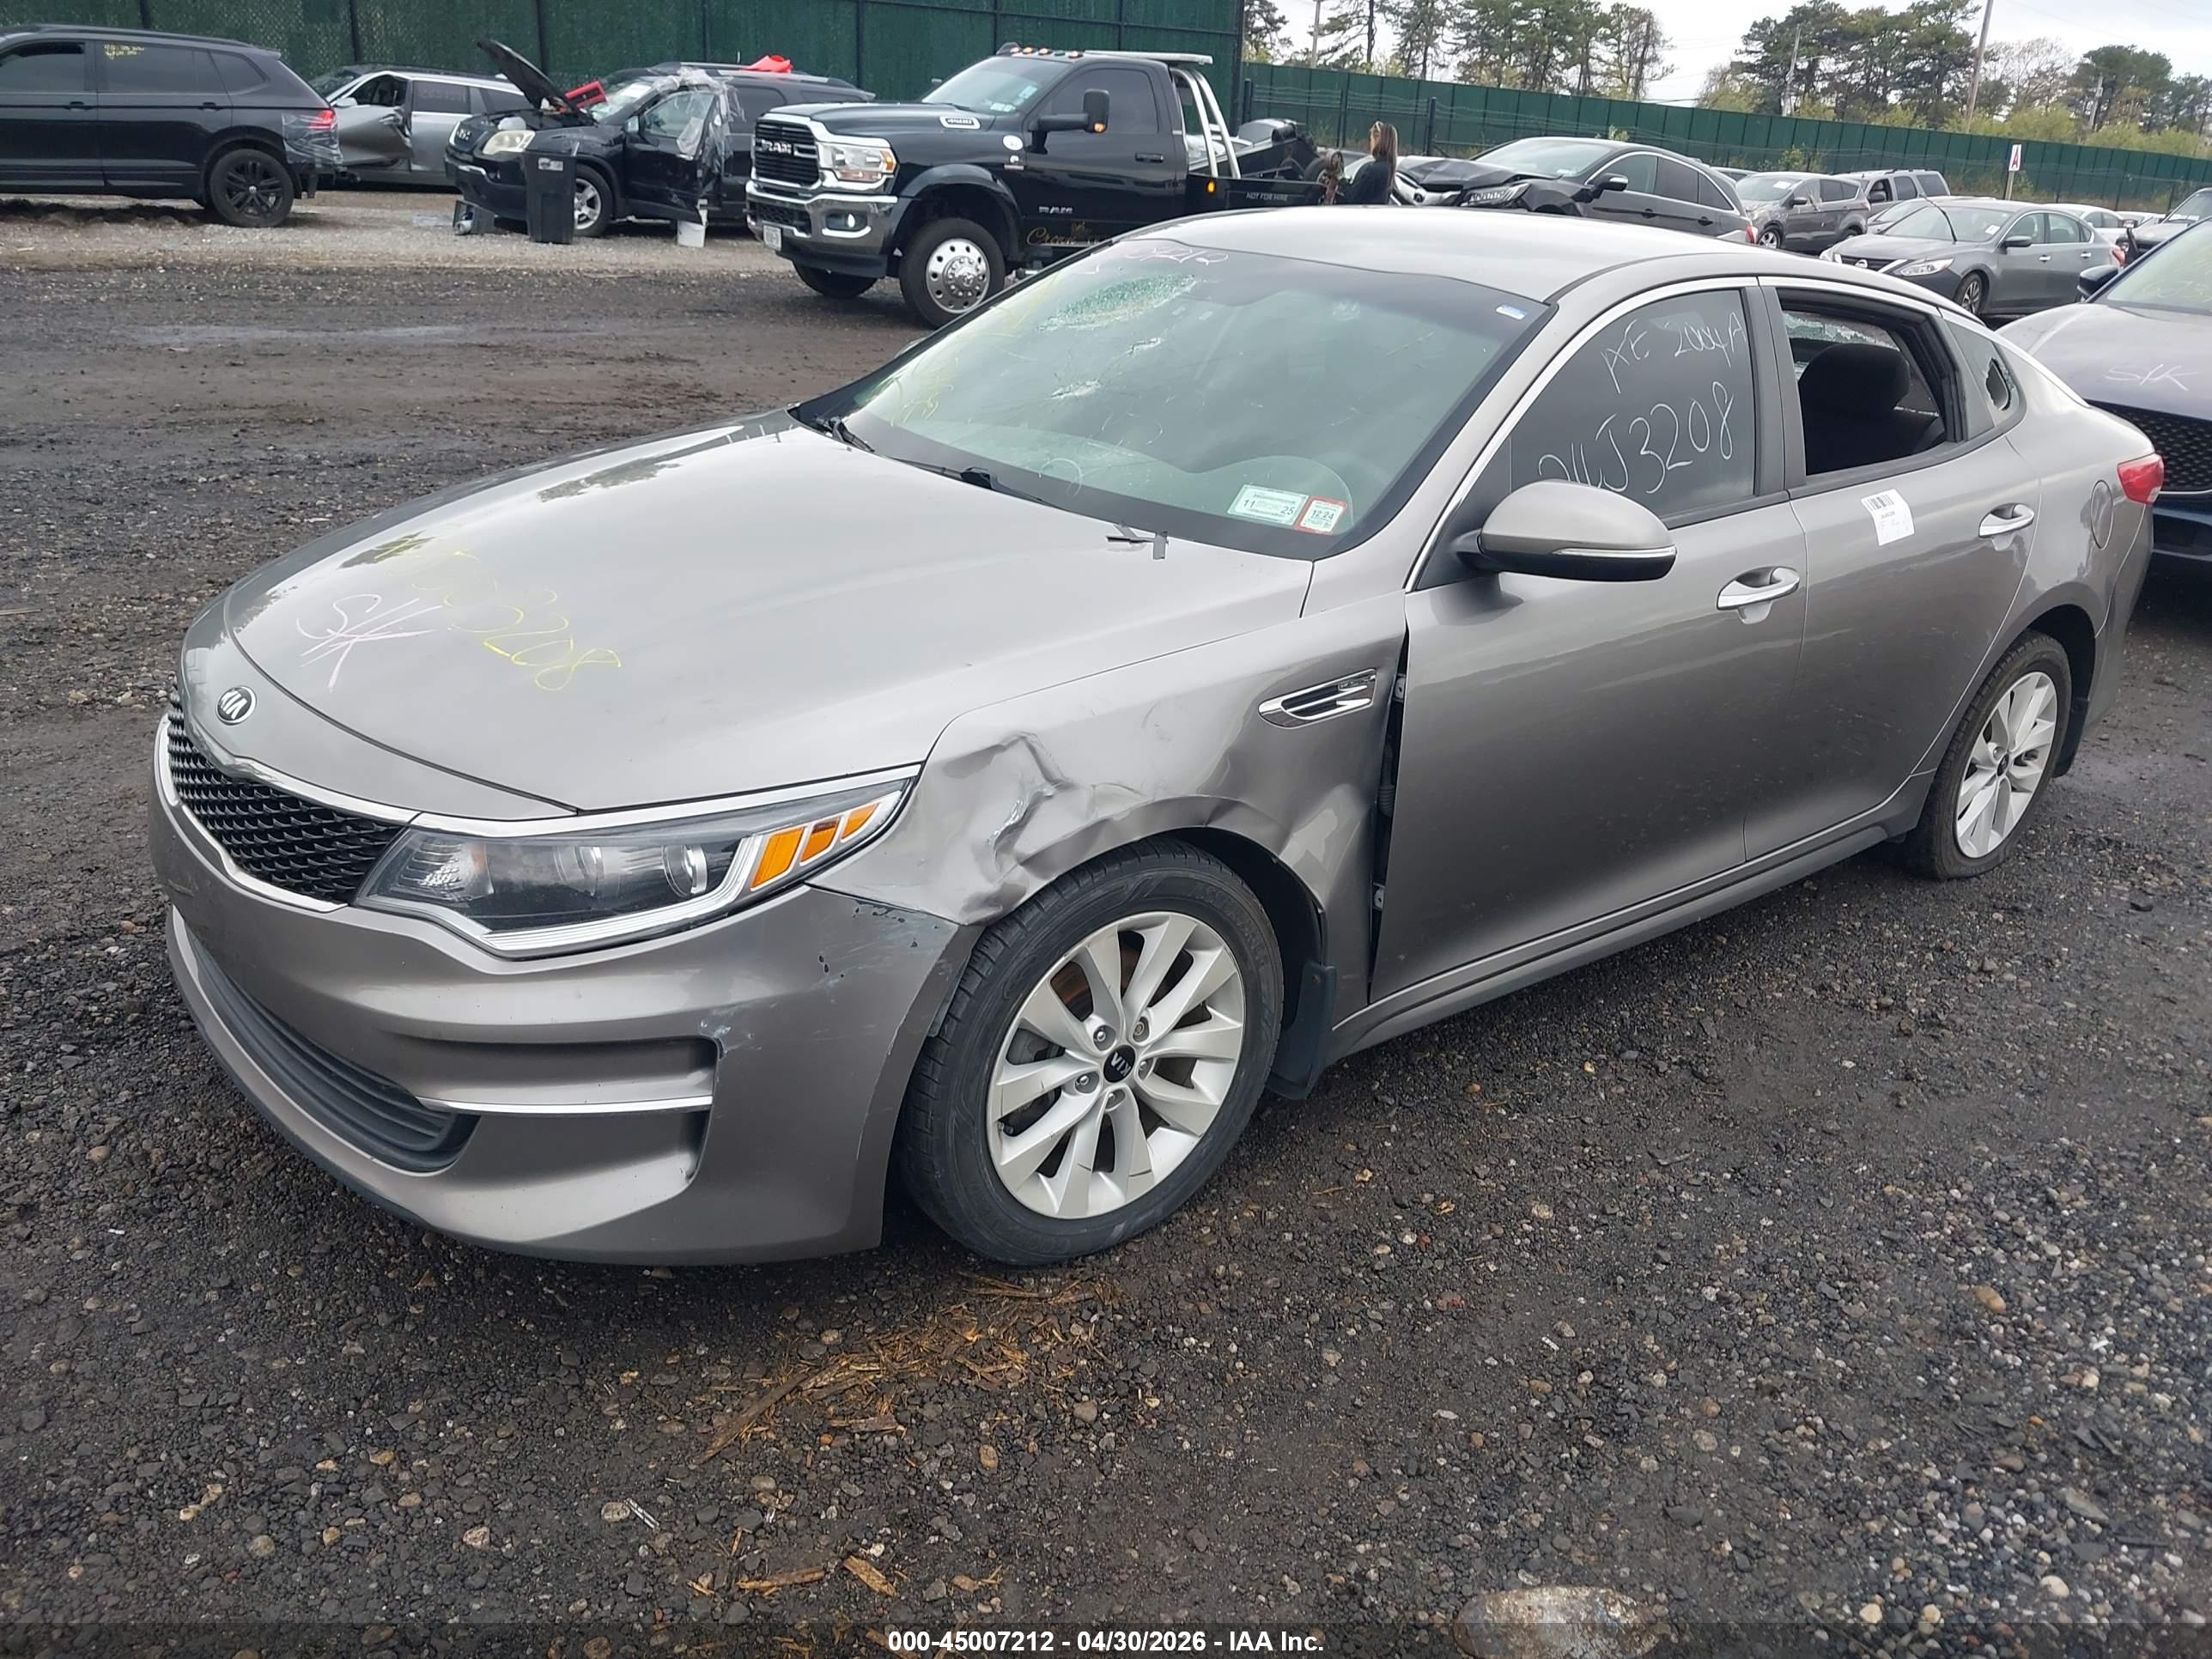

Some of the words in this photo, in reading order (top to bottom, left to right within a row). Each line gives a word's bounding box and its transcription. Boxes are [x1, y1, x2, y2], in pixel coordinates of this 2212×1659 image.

[2011, 145, 2019, 168] A
[1243, 499, 1255, 509] 11
[1279, 507, 1295, 516] 25
[220, 690, 248, 720] KIA
[1110, 1051, 1132, 1078] KIA
